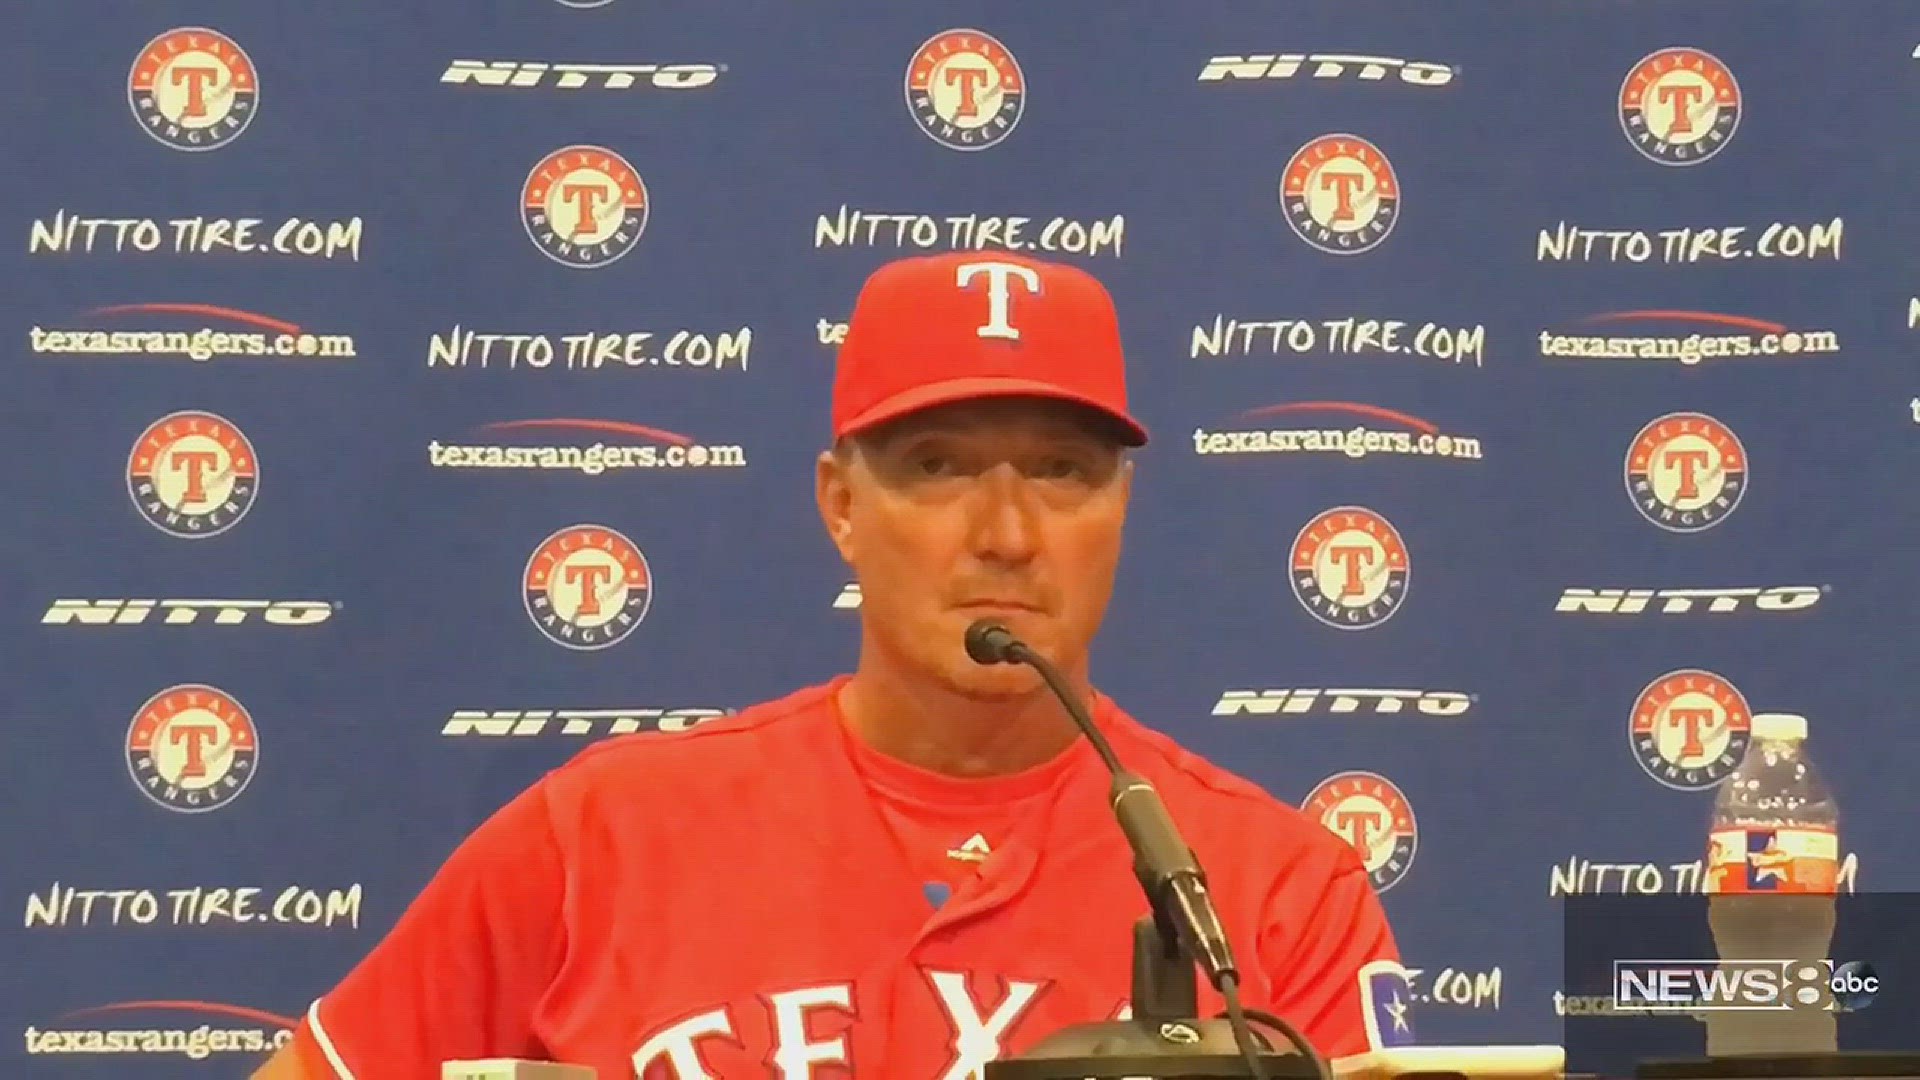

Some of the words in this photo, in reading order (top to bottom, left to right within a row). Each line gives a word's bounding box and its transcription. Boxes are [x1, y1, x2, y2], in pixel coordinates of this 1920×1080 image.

[150, 36, 239, 67] TEXAS
[923, 37, 1006, 69] TEXAS
[1198, 54, 1453, 86] NITTO
[1636, 54, 1722, 83] TEXAS
[170, 66, 220, 118] T
[440, 60, 717, 89] NITTO
[944, 67, 988, 118] T
[139, 96, 249, 144] RANGERS
[914, 96, 1017, 144] RANGERS
[1657, 84, 1703, 135] T
[1299, 141, 1381, 172] TEXAS
[1626, 114, 1732, 161] RANGERS
[541, 153, 629, 184] TEXAS
[561, 184, 609, 235] T
[1320, 171, 1364, 222] T
[531, 214, 639, 261] RANGERS
[1291, 203, 1392, 248] RANGERS
[956, 261, 1041, 339] T
[30, 325, 357, 361] texasrangers.com
[1540, 330, 1840, 365] texasrangers.com
[149, 420, 238, 451] TEXAS
[1193, 426, 1483, 459] texasrangers.com
[1644, 420, 1728, 449] TEXAS
[171, 450, 219, 503] T
[428, 440, 747, 475] texasrangers.com
[1664, 450, 1709, 500] T
[137, 482, 249, 530] RANGERS
[1634, 480, 1739, 525] RANGERS
[542, 533, 630, 564] TEXAS
[1309, 515, 1391, 544] TEXAS
[564, 564, 612, 616] T
[1329, 546, 1374, 596] T
[42, 598, 332, 625] NITTO
[532, 596, 642, 643] RANGERS
[1299, 577, 1402, 623] RANGERS
[1555, 587, 1821, 614] NITTO
[146, 693, 237, 723] TEXAS
[1212, 688, 1470, 716] NITTO
[1646, 676, 1734, 706] TEXAS
[442, 709, 723, 736] NITTO
[1668, 708, 1714, 758] T
[169, 724, 219, 777] T
[1638, 736, 1744, 783] RANGERS
[136, 757, 250, 805] RANGERS
